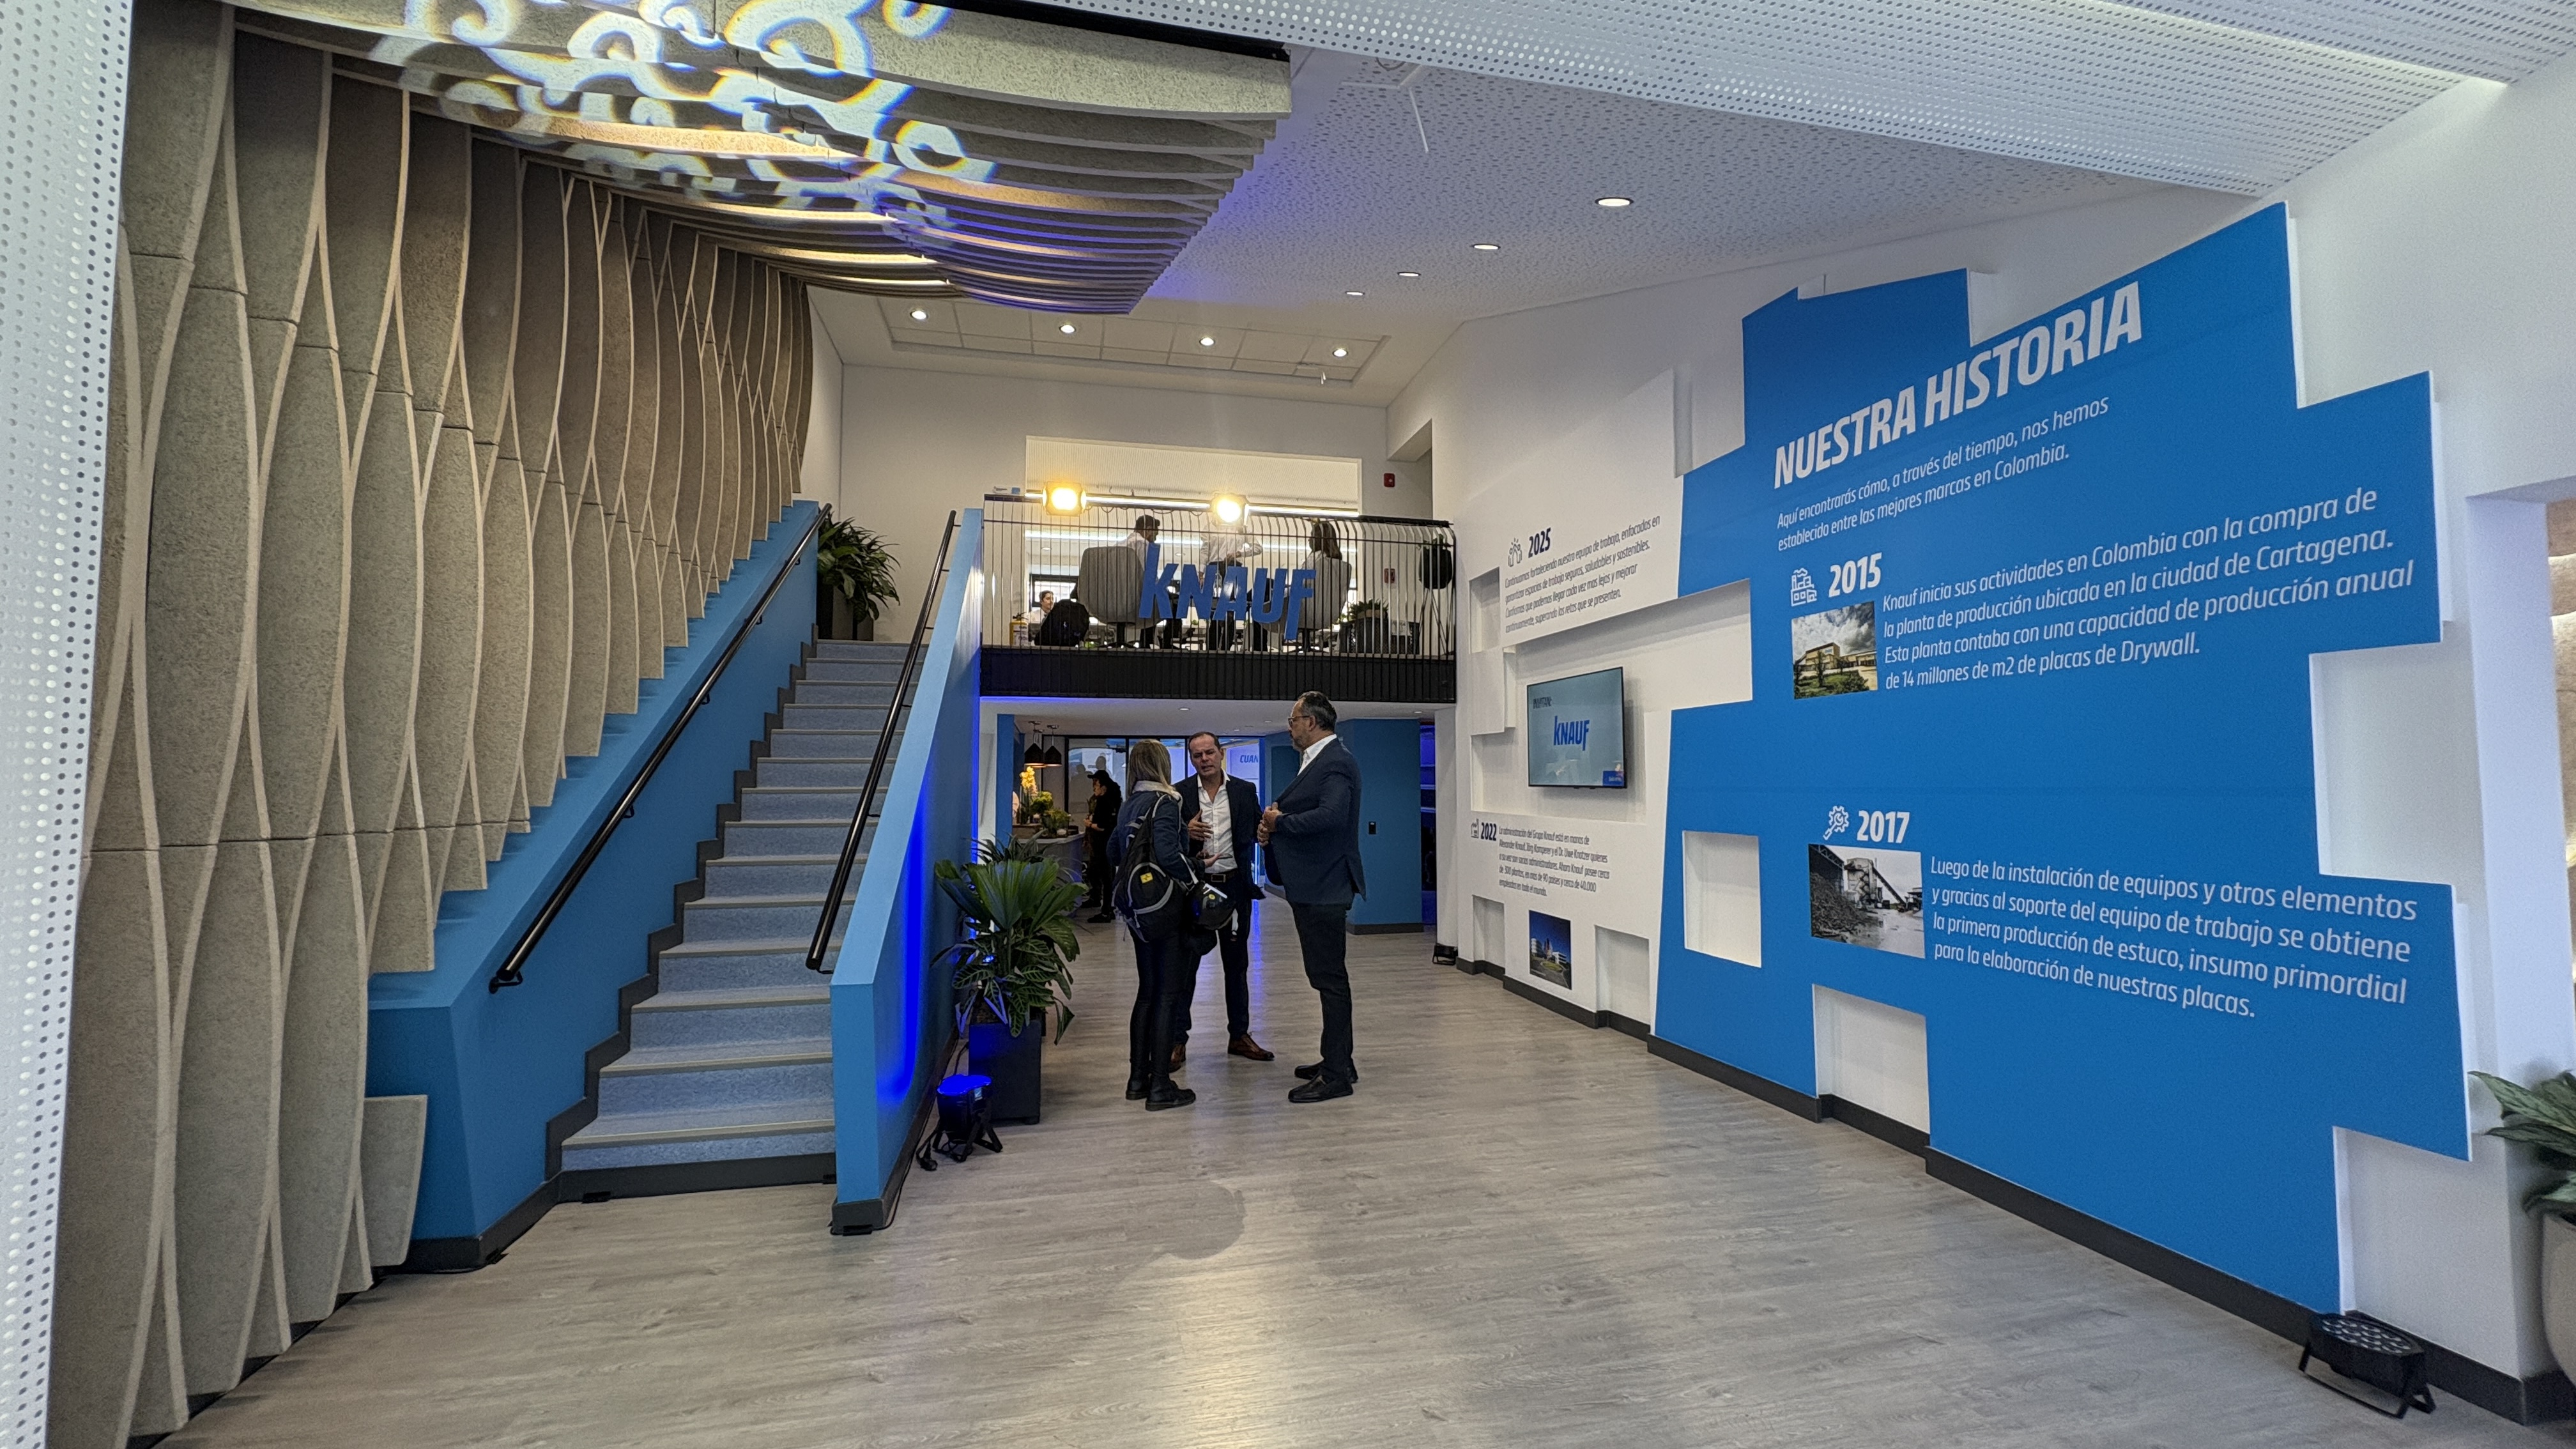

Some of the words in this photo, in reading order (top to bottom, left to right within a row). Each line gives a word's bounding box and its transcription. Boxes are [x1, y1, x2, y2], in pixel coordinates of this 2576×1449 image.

[1773, 385, 1916, 489] NUESTRA
[1924, 280, 2143, 427] HISTORIA
[1777, 507, 1799, 529] Aquí
[1798, 487, 1857, 521] encontrarás
[1858, 478, 1890, 500] cómo,
[1892, 473, 1901, 487] a
[1902, 456, 1940, 484] través
[1942, 446, 1963, 470] del
[1965, 432, 2018, 461] tiempo,
[2021, 418, 2049, 442] nos
[2052, 397, 2109, 431] hemos
[1778, 522, 1829, 551] establecido
[1830, 514, 1858, 534] entre
[1859, 508, 1875, 525] las
[1877, 492, 1922, 519] mejores
[1924, 475, 1972, 504] marcas
[1974, 469, 1991, 487] en
[1994, 443, 2069, 480] Colombia.
[1528, 528, 1551, 558] 2025
[1542, 579, 1547, 589] de
[1547, 572, 1564, 586] trabajo
[1584, 554, 1612, 573] saludables
[1613, 553, 1616, 564] y
[1617, 540, 1650, 561] sostenibles.
[1558, 553, 1574, 567] nuestro
[1575, 545, 1592, 560] equipo
[1593, 540, 1599, 552] de
[1621, 519, 1651, 540] enfocados
[1652, 516, 1660, 527] en
[1828, 552, 1882, 597] 2015
[1883, 588, 1919, 612] Knauf
[1919, 582, 1952, 604] inicia
[1954, 579, 1977, 597] sus
[1979, 558, 2064, 592] actividades
[2067, 555, 2088, 573] en
[2092, 532, 2177, 568] Colombia
[2182, 525, 2218, 549] con
[2223, 517, 2243, 540] la
[2248, 498, 2338, 535] compra
[2345, 487, 2377, 515] de
[1139, 542, 1316, 640] KNAUF
[1552, 590, 1565, 602] llegar
[1565, 584, 1577, 597] cada
[1598, 574, 1610, 587] lejos
[1611, 572, 1614, 584] y
[1616, 564, 1637, 580] mejorar
[1564, 603, 1577, 614] retos
[1577, 600, 1586, 612] que
[1587, 598, 1593, 607] se
[1884, 621, 1894, 638] la
[1896, 615, 1935, 639] planta
[1937, 610, 1953, 628] de
[1955, 594, 2032, 629] producción
[2035, 581, 2100, 611] ubicada
[2104, 579, 2126, 598] en
[2130, 572, 2147, 594] la
[2152, 556, 2220, 590] ciudad
[2224, 552, 2251, 577] de
[2256, 529, 2393, 571] Cartagena.
[1885, 646, 1910, 664] Esta
[1911, 639, 1952, 663] planta
[1954, 629, 2010, 653] contaba
[2013, 626, 2039, 645] con
[2043, 621, 2074, 640] una
[2078, 600, 2171, 636] capacidad
[2175, 597, 2200, 621] de
[2204, 576, 2329, 622] producción
[2335, 559, 2414, 597] anual
[1885, 672, 1900, 690] de
[1902, 670, 1915, 687] 14
[1917, 666, 1970, 686] millones
[1972, 660, 1989, 680] de
[1991, 656, 2014, 677] m2
[2017, 654, 2036, 674] de
[2039, 650, 2092, 676] placas
[2094, 643, 2117, 665] de
[2120, 631, 2200, 664] Drywall.
[1553, 716, 1590, 751] KNAUF
[1481, 822, 1496, 841] 2022
[1857, 809, 1910, 843] 2017
[1931, 855, 1970, 880] Luego
[1972, 859, 1989, 879] de
[1991, 861, 2005, 880] la
[2008, 862, 2094, 889] instalación
[2097, 870, 2120, 892] de
[2123, 874, 2198, 901] equipos
[2202, 883, 2216, 905] y
[2220, 882, 2276, 907] otros
[2281, 885, 2418, 921] elementos
[1931, 888, 1940, 905] y
[1942, 888, 1989, 908] gracias
[1992, 891, 2006, 910] al
[2008, 896, 2067, 918] soporte
[2070, 900, 2096, 922] del
[2099, 906, 2161, 932] equipo
[2165, 910, 2190, 934] de
[2195, 914, 2273, 947] trabajo
[2278, 928, 2304, 949] se
[2310, 927, 2411, 963] obtiene
[1933, 912, 1945, 930] la
[1947, 916, 2000, 939] primera
[2003, 925, 2089, 953] producción
[2092, 935, 2114, 958] de
[2117, 942, 2184, 972] estuco,
[2189, 947, 2268, 981] insumo
[2273, 963, 2407, 1004] primordial
[1934, 944, 1965, 962] para
[1967, 945, 1980, 965] la
[1982, 949, 2069, 982] elaboración
[2073, 964, 2094, 986] de
[2097, 972, 2178, 1002] nuestras
[2182, 985, 2255, 1018] placas.
